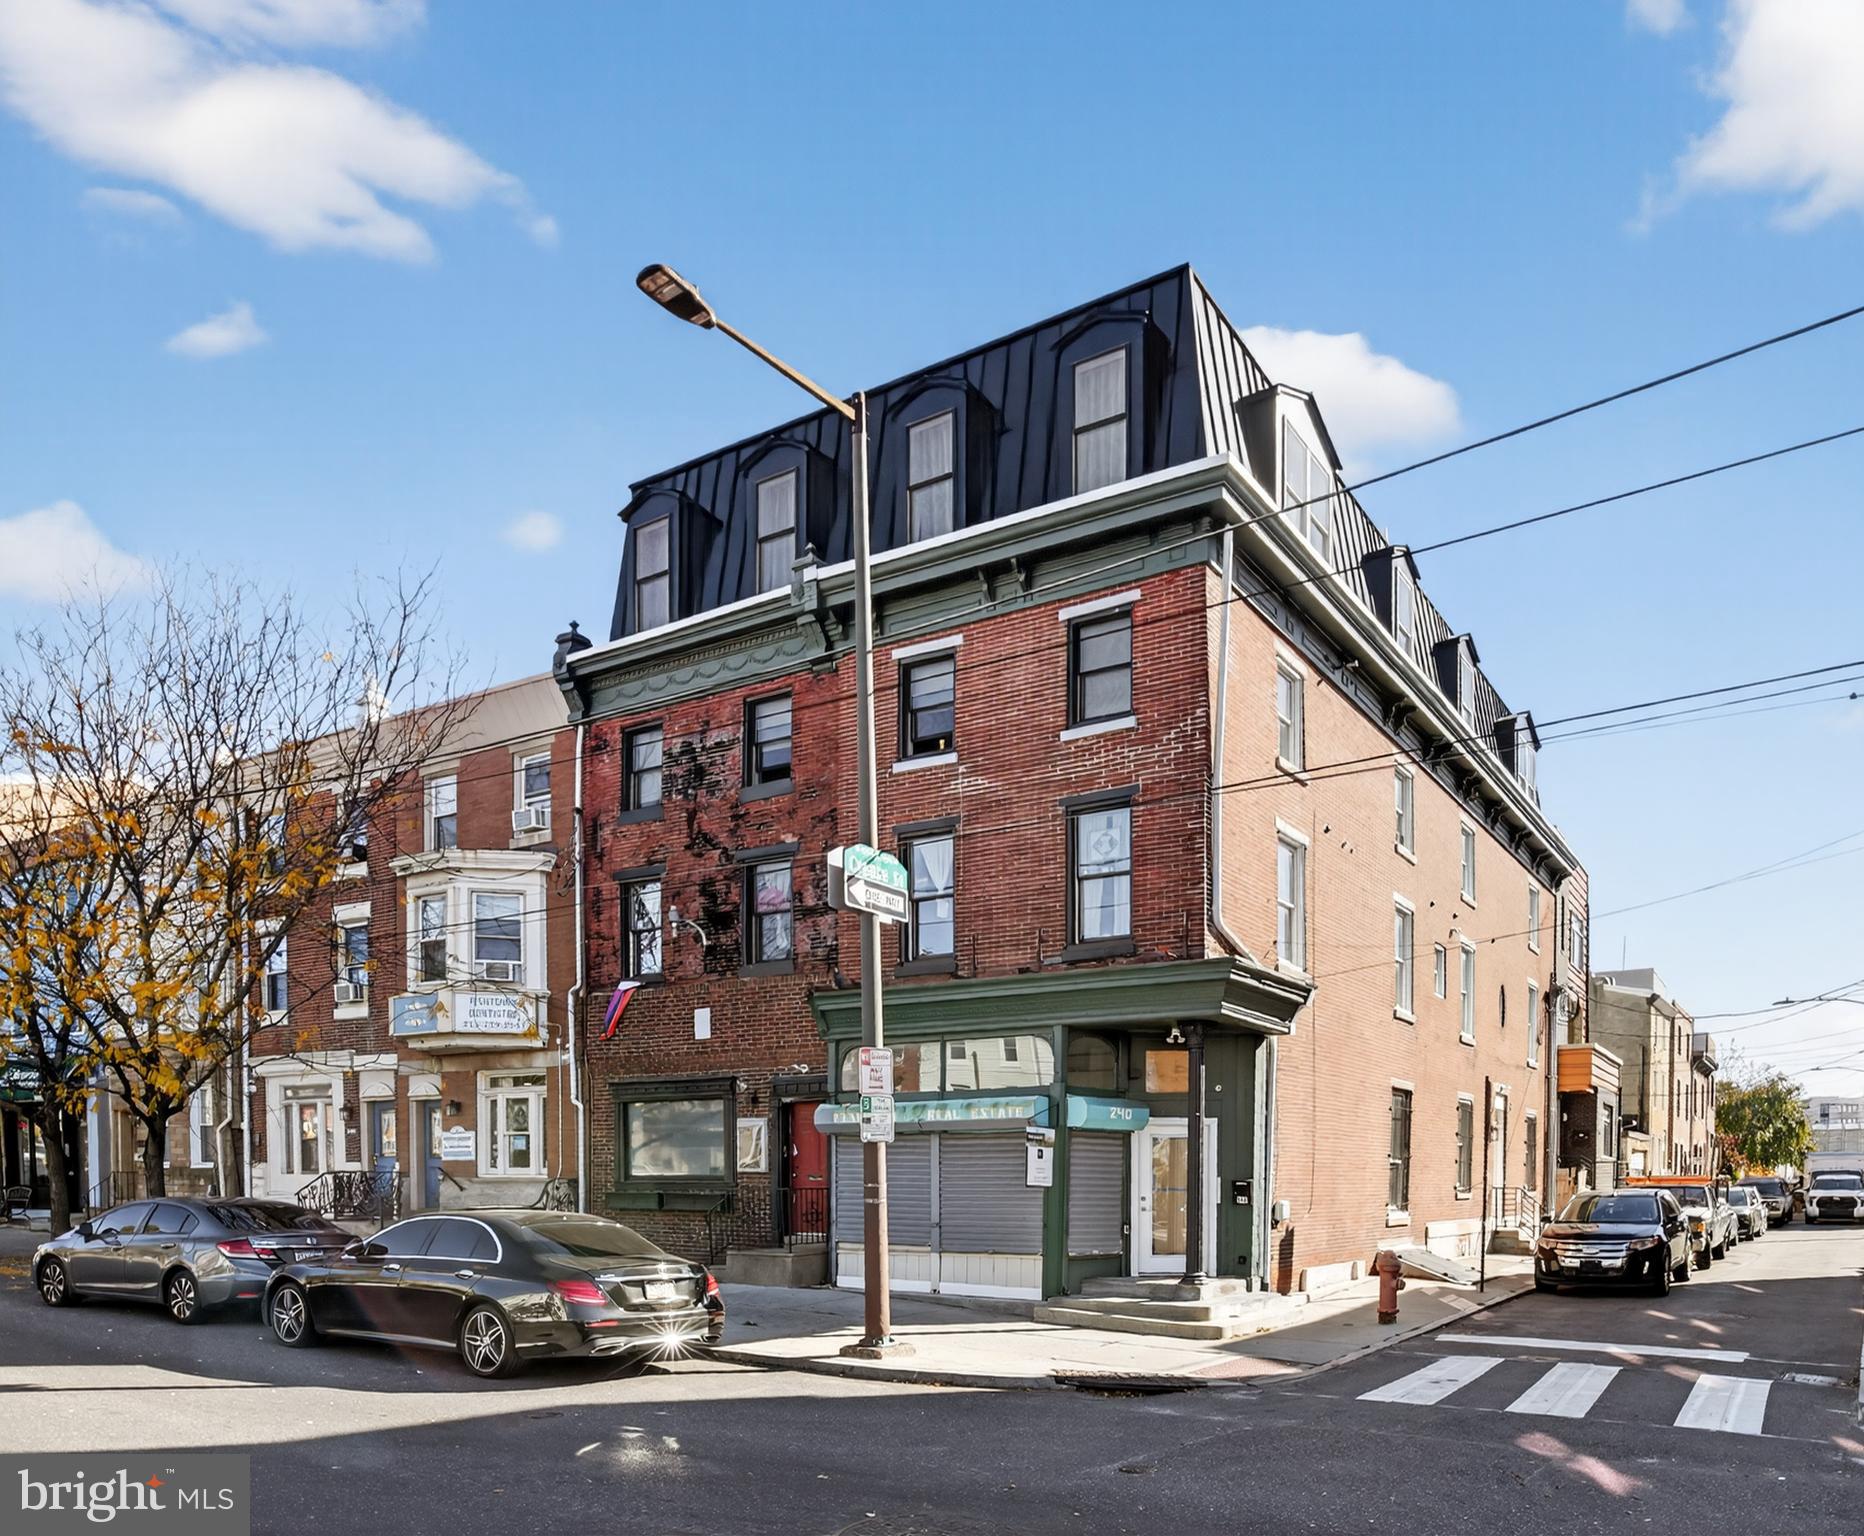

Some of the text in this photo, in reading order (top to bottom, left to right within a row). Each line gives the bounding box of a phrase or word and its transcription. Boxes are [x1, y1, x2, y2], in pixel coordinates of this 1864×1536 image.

[927, 1106, 1025, 1121] REAL ESTATE
[1110, 1106, 1133, 1120] 240
